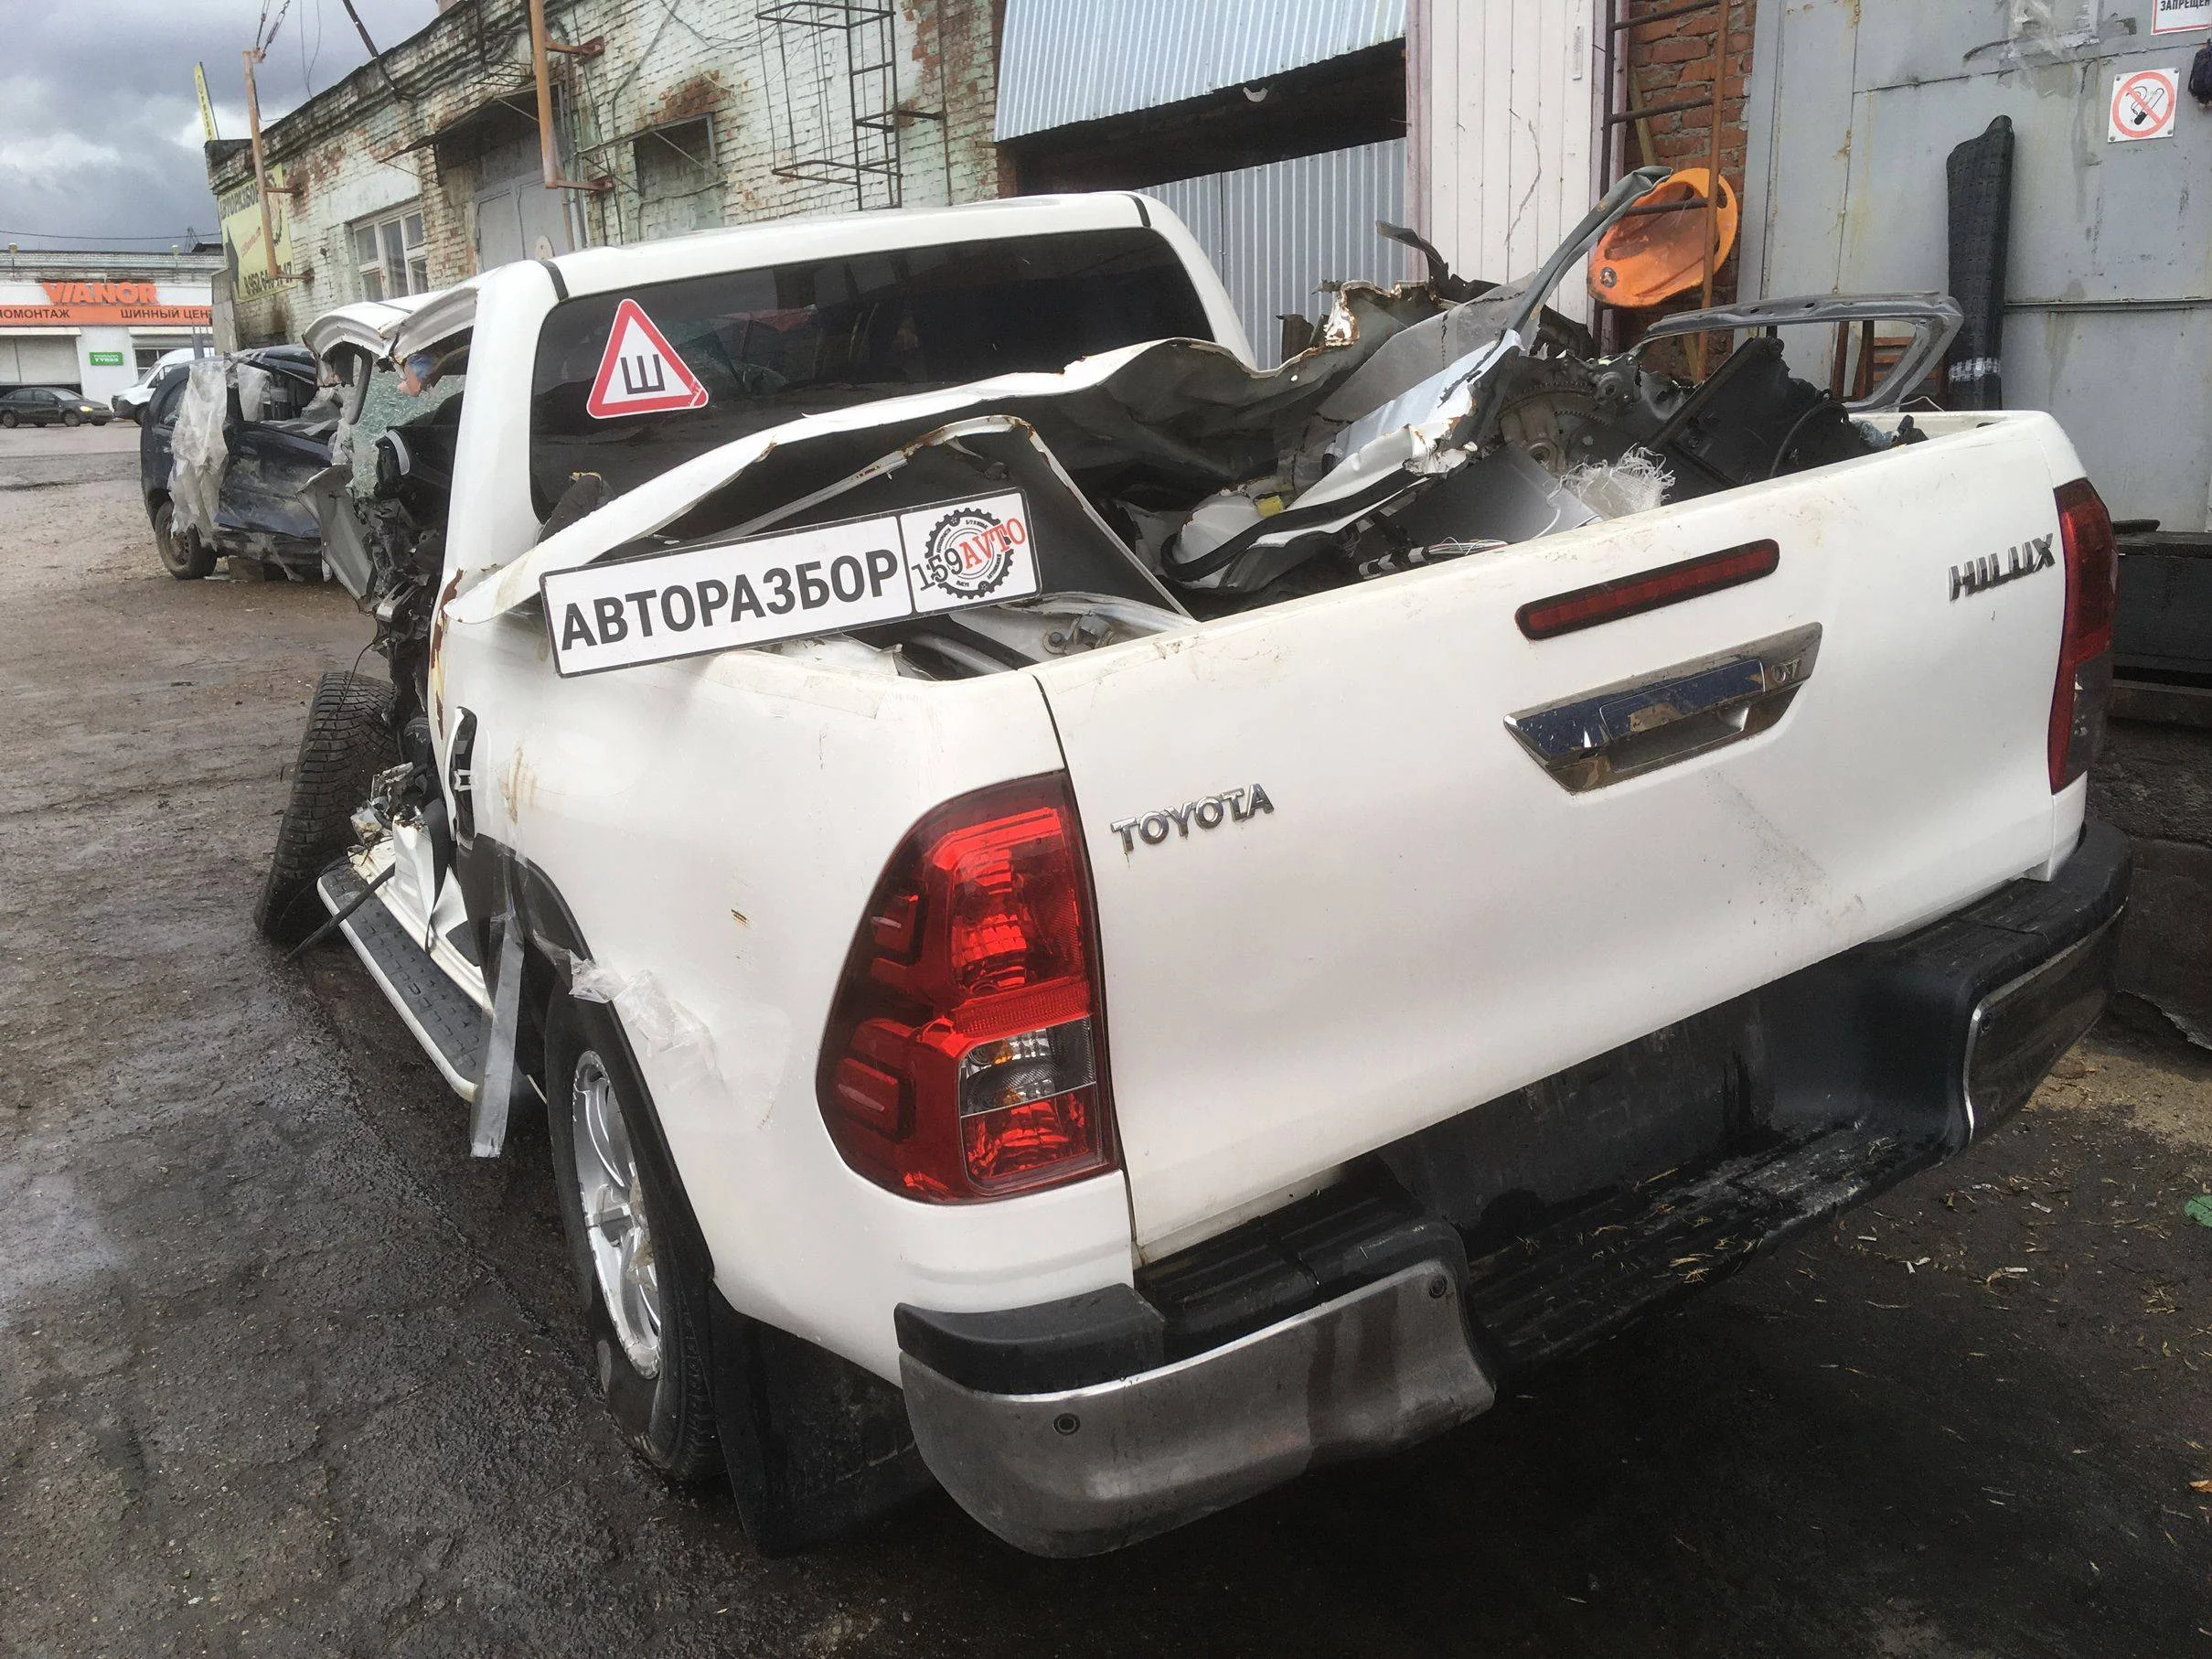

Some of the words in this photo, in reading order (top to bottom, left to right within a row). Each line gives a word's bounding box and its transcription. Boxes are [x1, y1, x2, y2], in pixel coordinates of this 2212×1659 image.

[41, 282, 158, 305] VIANOR
[121, 308, 179, 318] ШИННЫЙ
[620, 354, 666, 395] Ш
[1949, 533, 2056, 602] HILUX
[561, 549, 899, 651] АВТОРАЗБОР
[1110, 783, 1275, 851] TOYOTA
